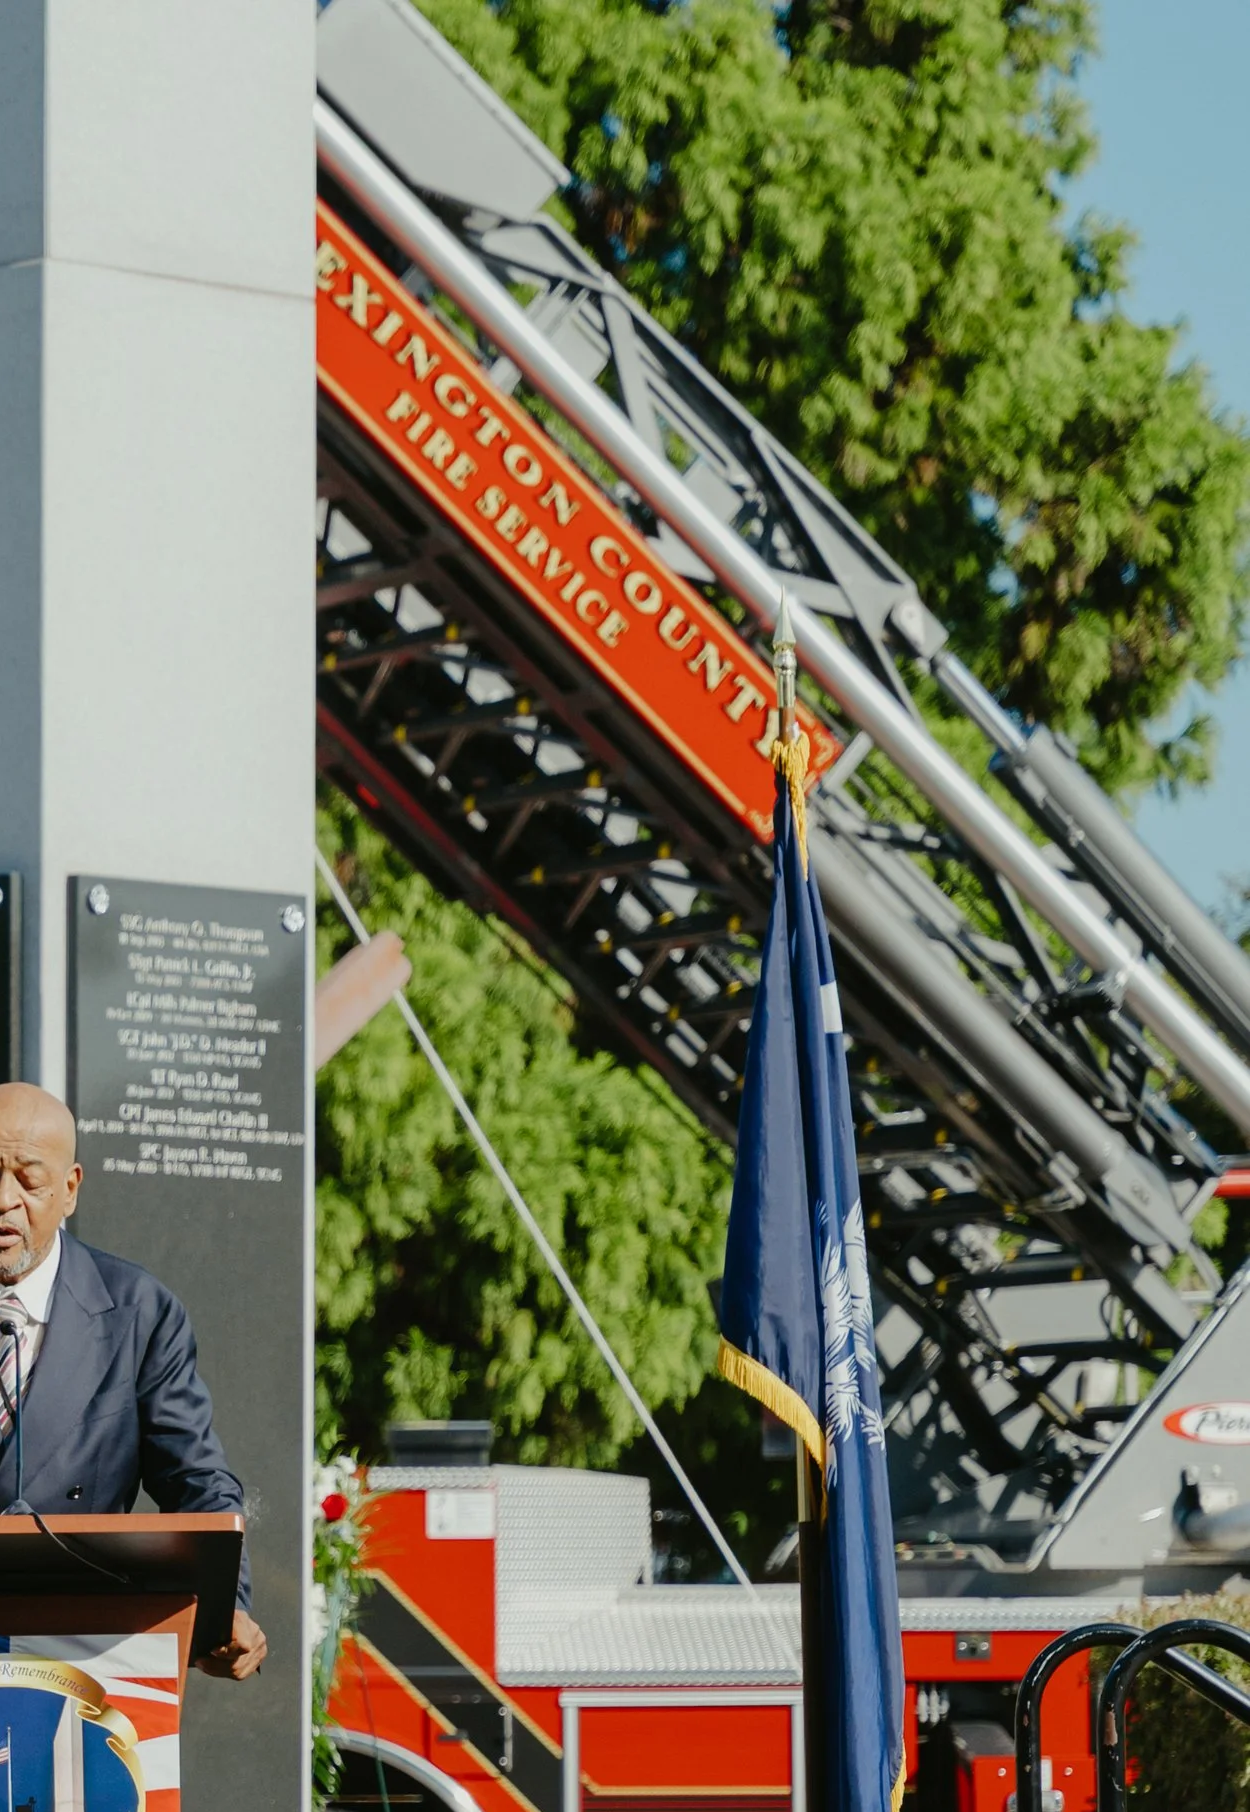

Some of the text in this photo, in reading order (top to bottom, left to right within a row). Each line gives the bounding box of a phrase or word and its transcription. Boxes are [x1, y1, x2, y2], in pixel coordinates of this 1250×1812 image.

[385, 390, 631, 649] FIRE SERVICE
[0, 1662, 90, 1696] Remembrance
